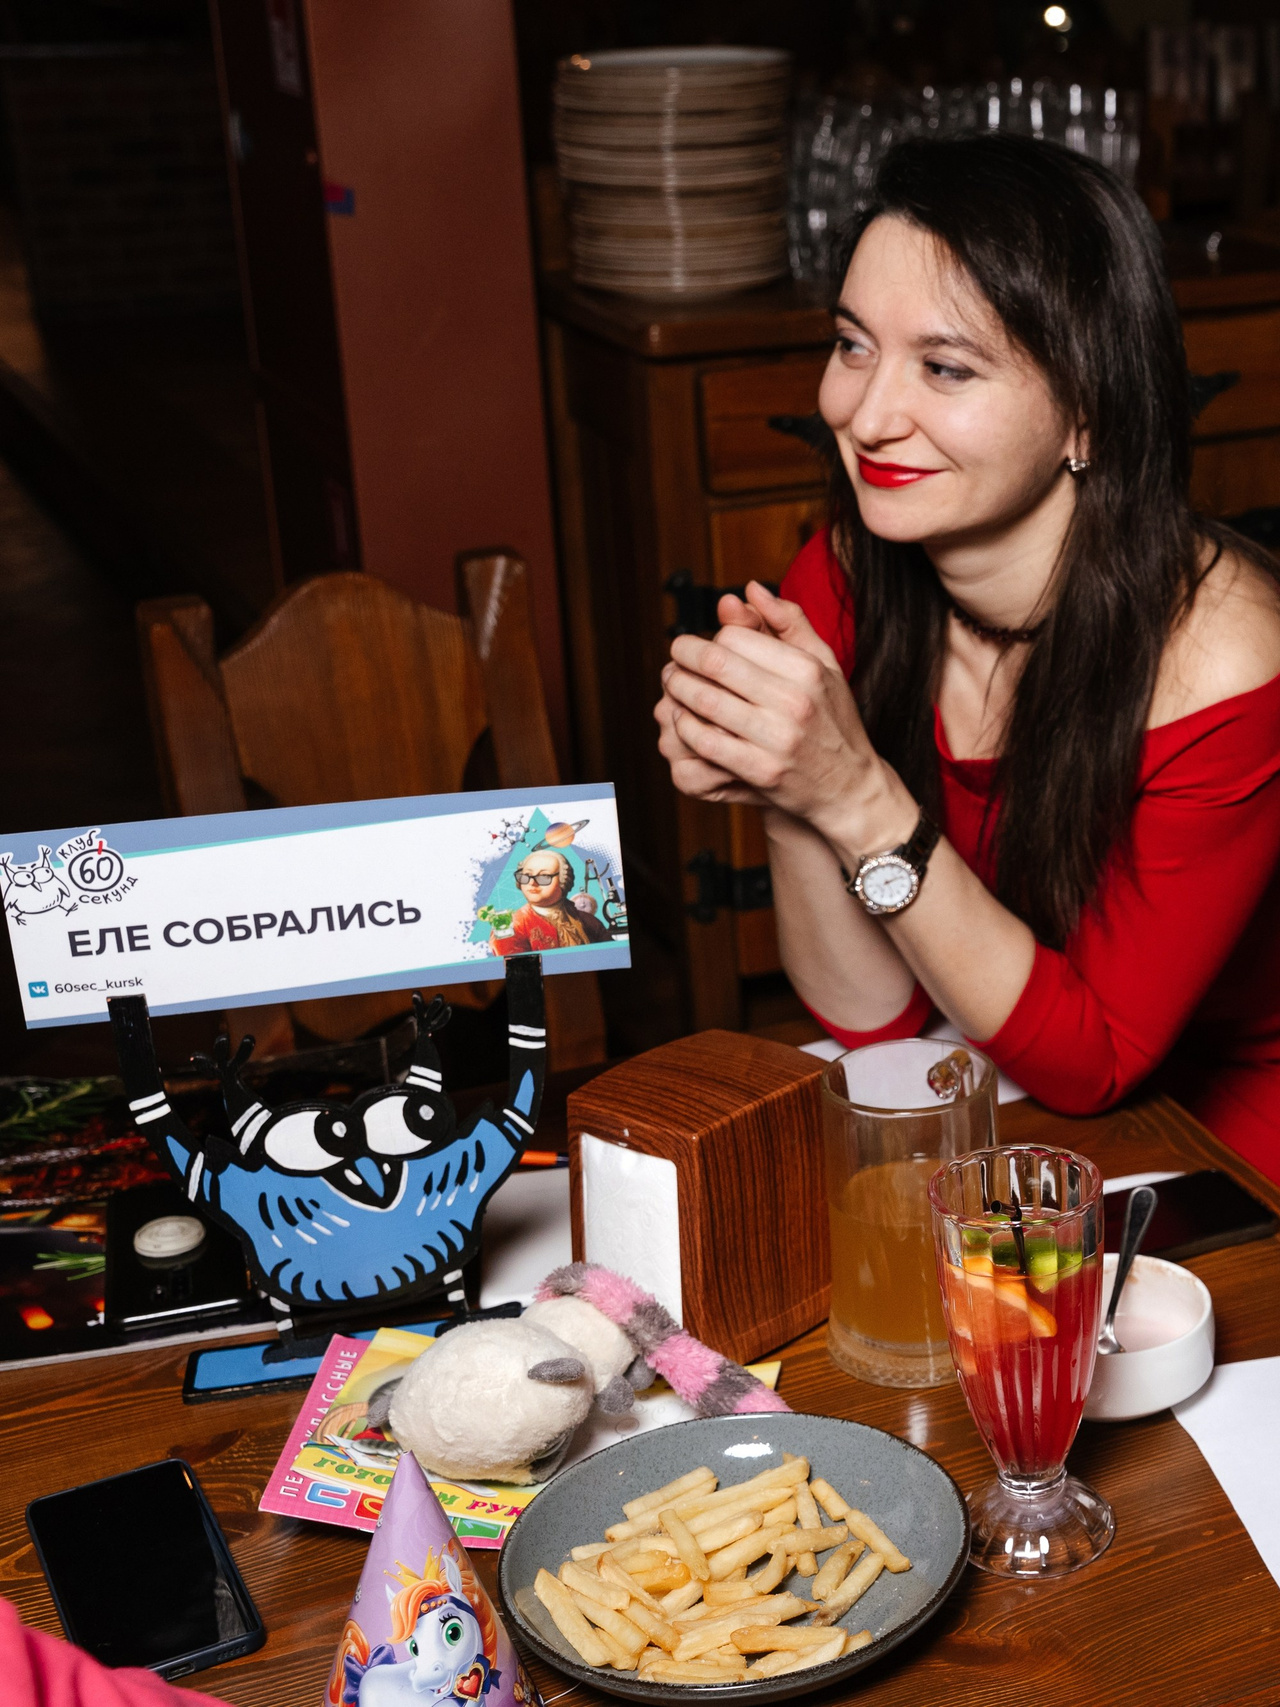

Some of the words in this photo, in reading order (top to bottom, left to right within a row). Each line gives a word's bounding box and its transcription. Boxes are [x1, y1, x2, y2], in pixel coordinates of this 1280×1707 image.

[79, 856, 114, 884] 60
[67, 924, 152, 958] ЕЛЕ
[162, 899, 422, 948] СОБРАЛИСЬ
[54, 976, 144, 994] 60sec_kursk
